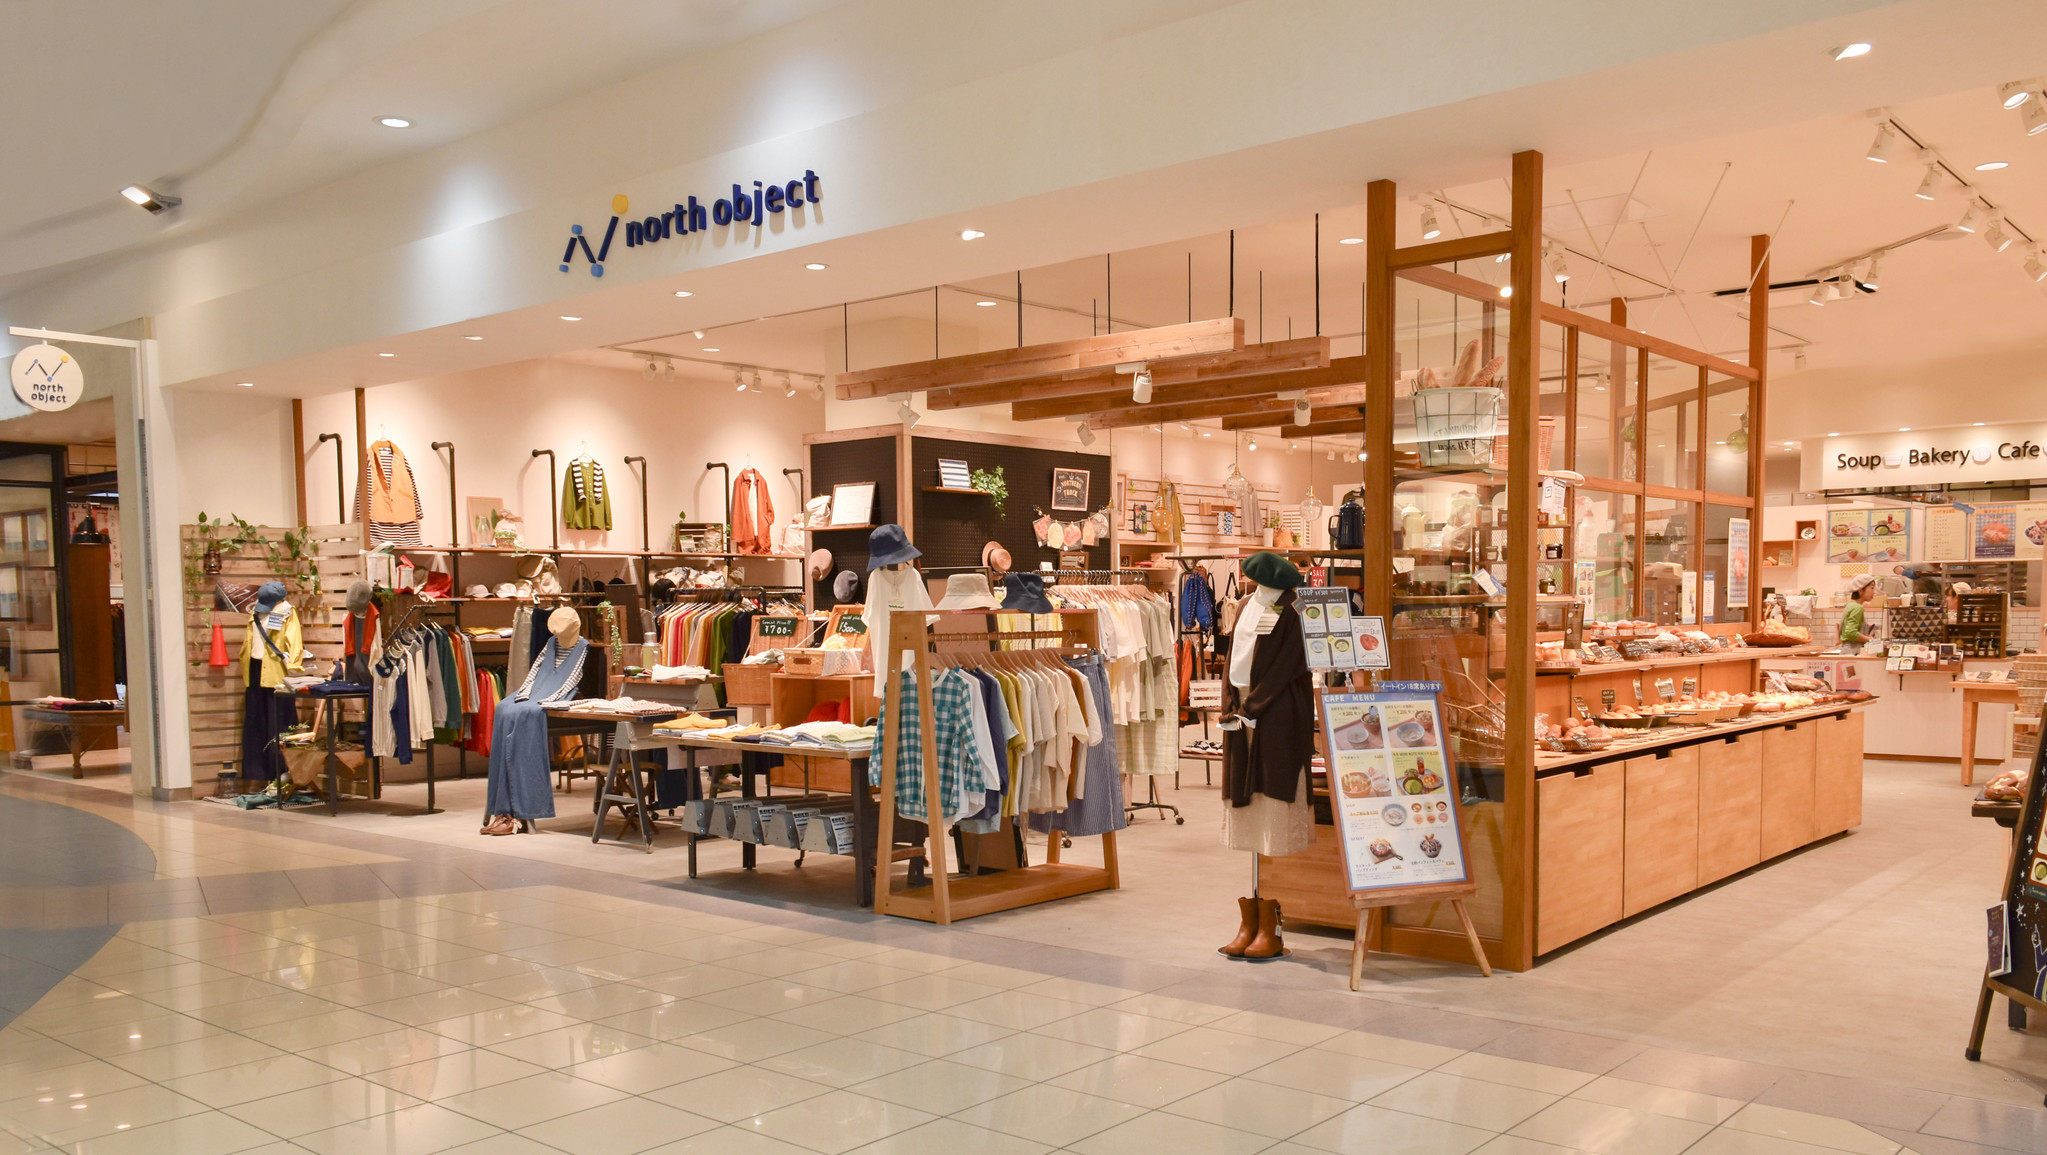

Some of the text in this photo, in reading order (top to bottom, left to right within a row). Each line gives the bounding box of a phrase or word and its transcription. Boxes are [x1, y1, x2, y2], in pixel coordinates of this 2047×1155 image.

[626, 170, 819, 247] north object
[33, 383, 64, 393] north
[31, 392, 67, 403] object
[1837, 441, 2041, 470] Soup Bakery Cafe
[1381, 682, 1441, 691] イートイン18席あります
[1324, 694, 1376, 703] CAFE MENU
